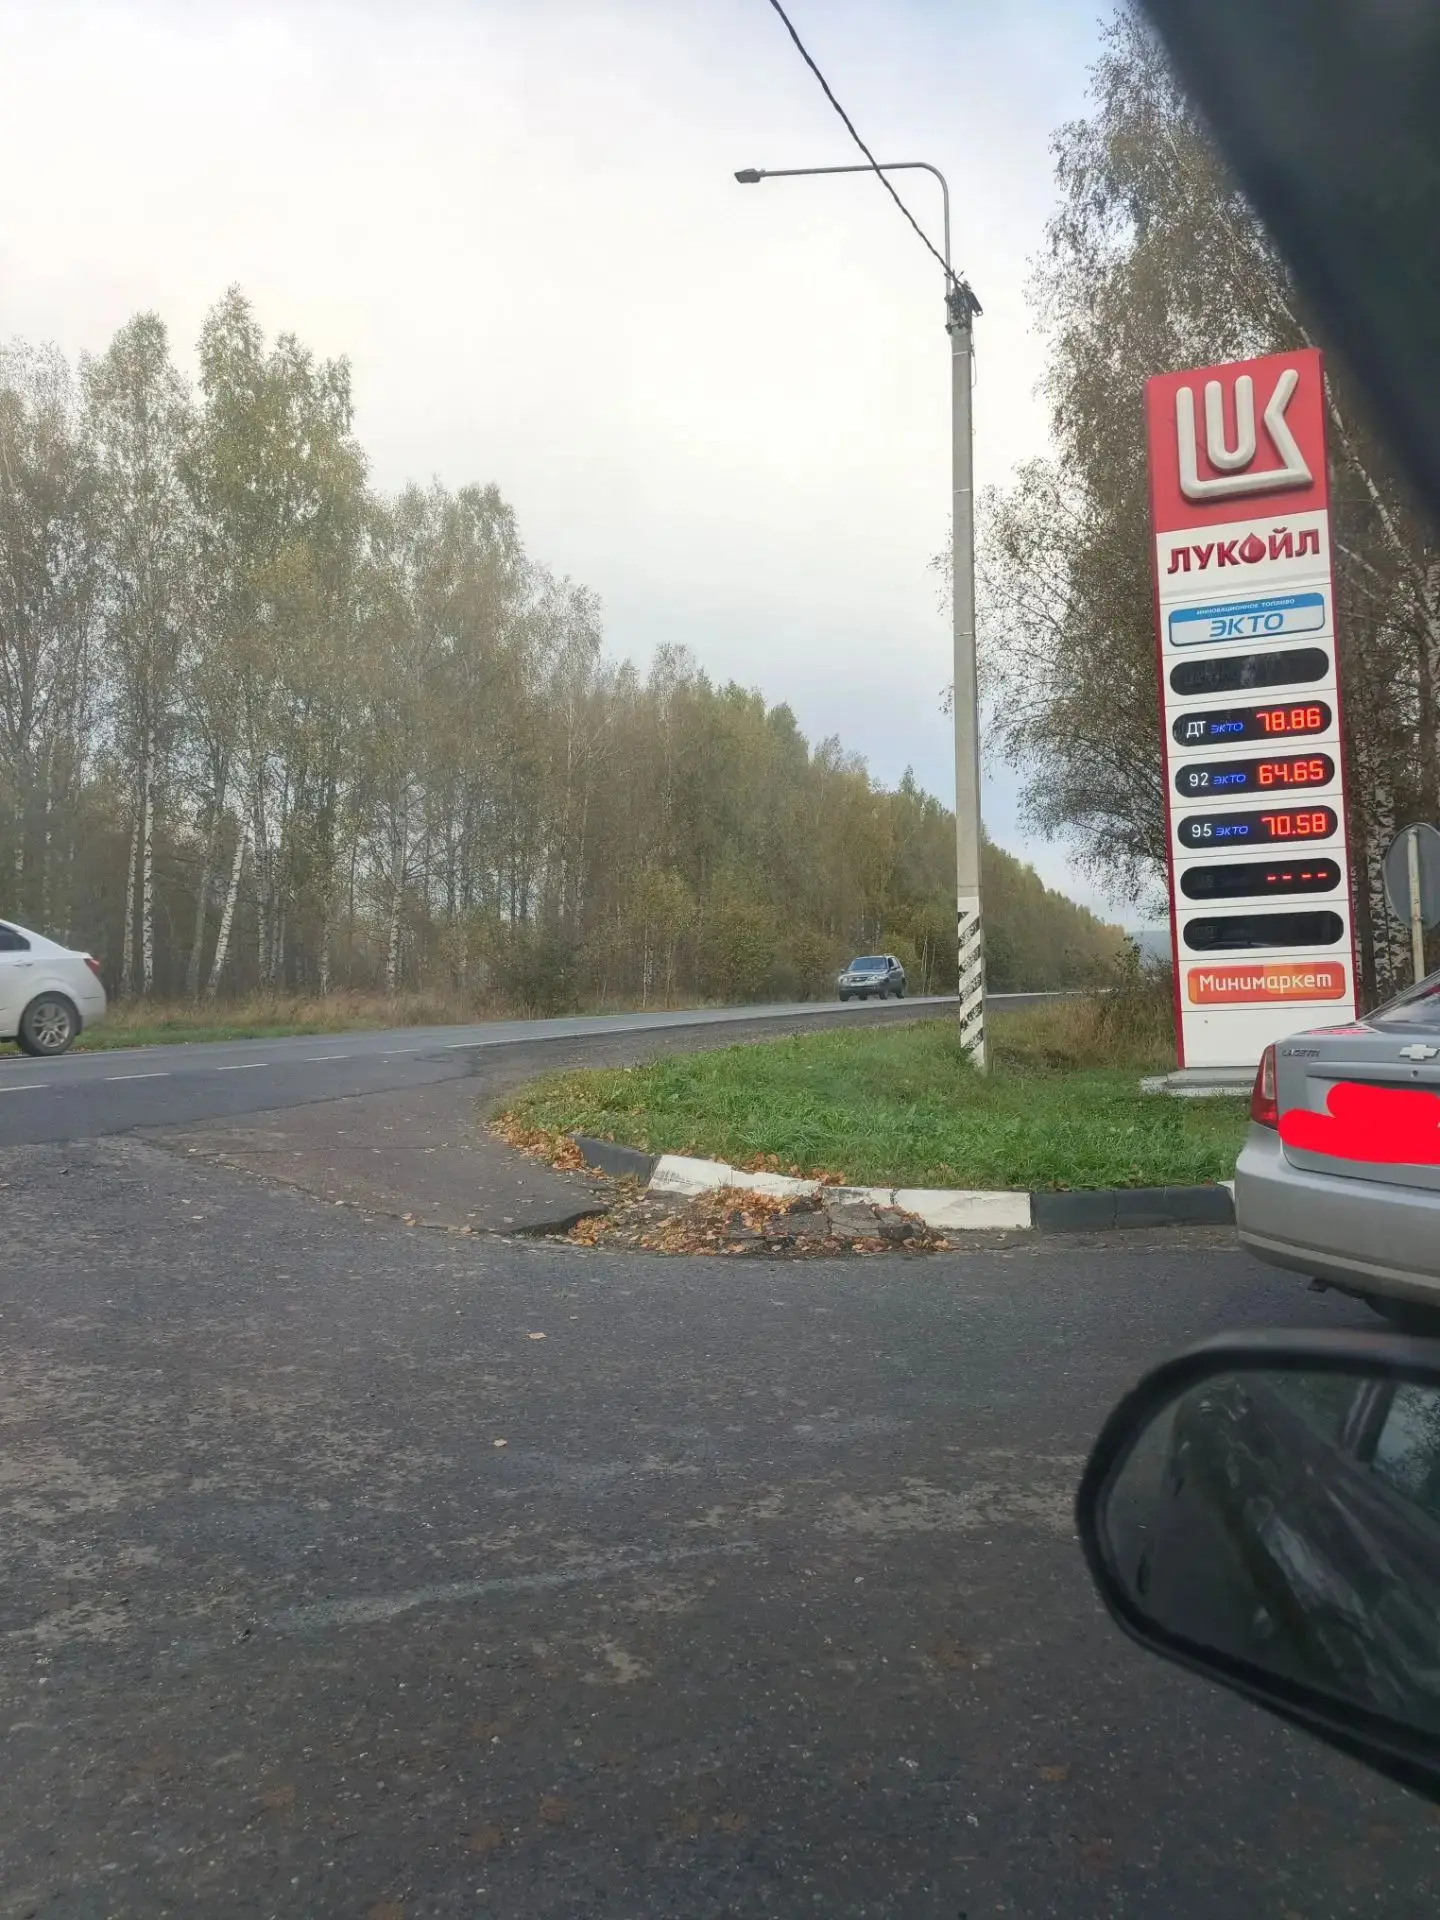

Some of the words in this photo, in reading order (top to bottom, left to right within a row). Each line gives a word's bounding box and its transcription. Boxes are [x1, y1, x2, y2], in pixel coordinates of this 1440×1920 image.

[1167, 527, 1321, 574] ЛУКОЙЛ
[1262, 599, 1295, 608] ТОПЛИВО
[1209, 613, 1284, 637] ЭКТО
[1186, 721, 1206, 738] ДТ
[1210, 722, 1244, 734] ЭКТО
[1256, 707, 1321, 732] 78.86
[1189, 772, 1209, 787] 92
[1213, 774, 1246, 785] ЭКТО
[1259, 760, 1324, 785] 64.65
[1192, 823, 1212, 838] 95
[1216, 825, 1249, 837] ЭКТО
[1261, 813, 1327, 836] 70.58
[1199, 973, 1332, 994] Минимаркет
